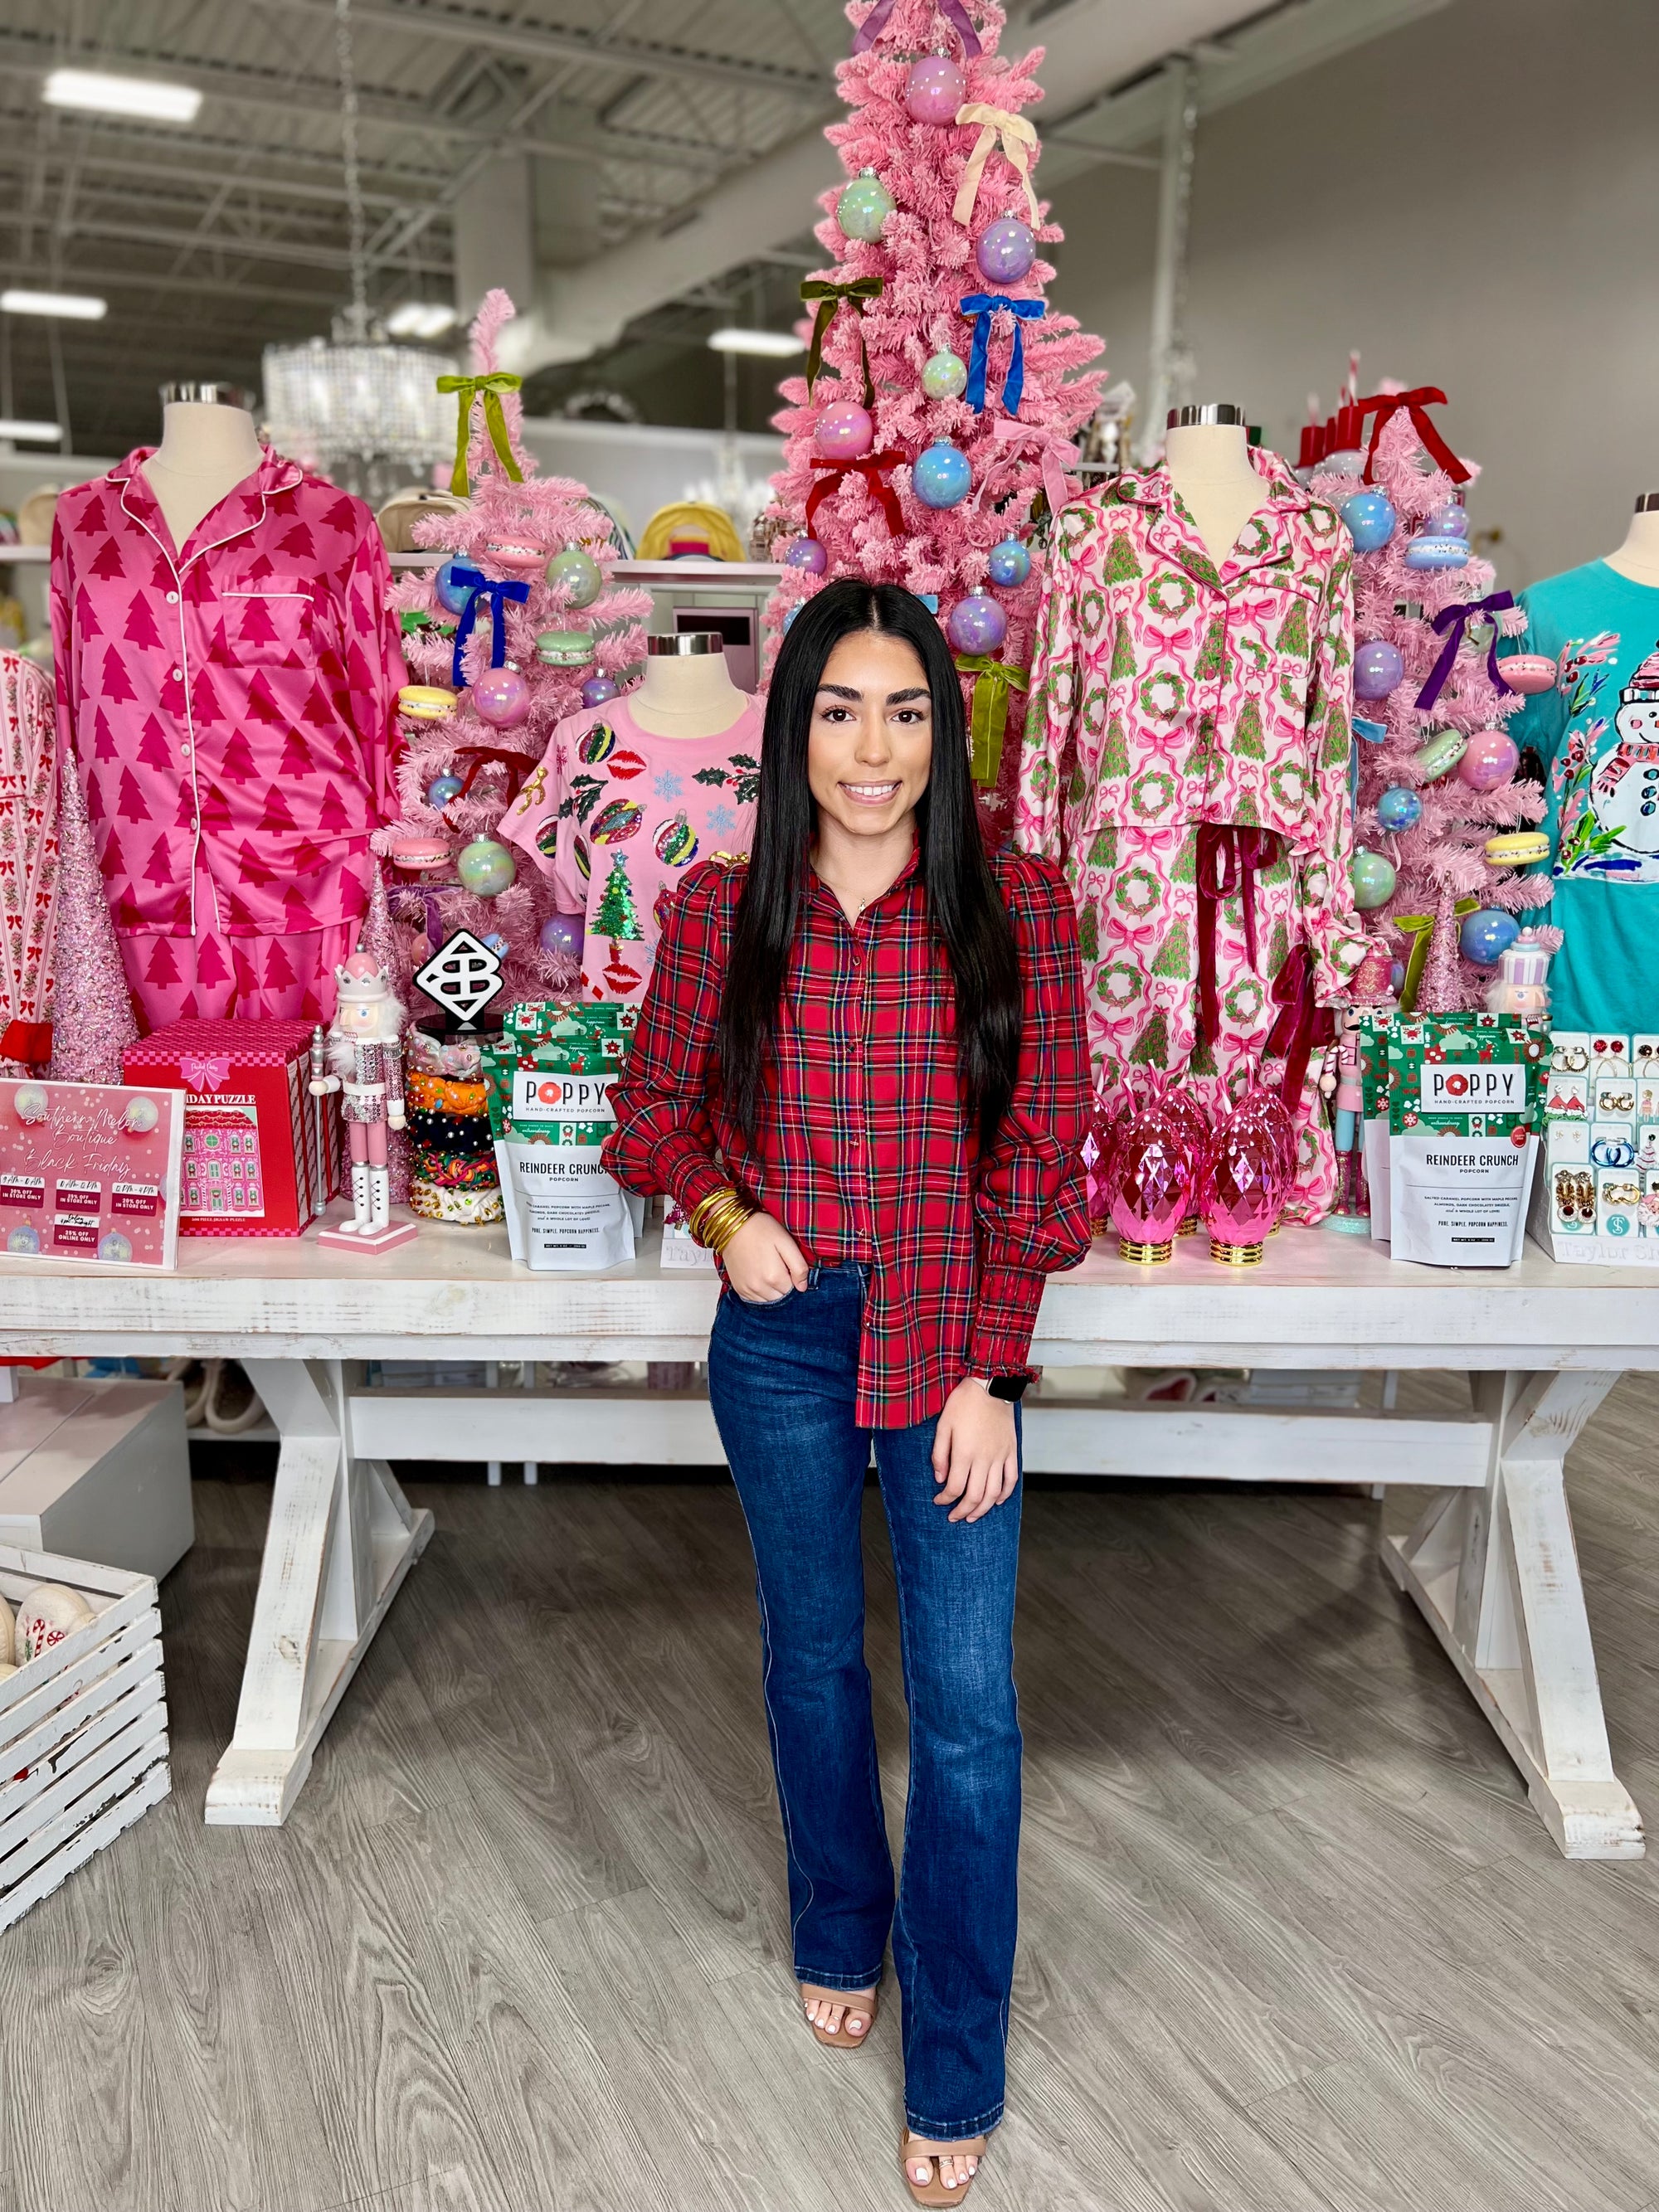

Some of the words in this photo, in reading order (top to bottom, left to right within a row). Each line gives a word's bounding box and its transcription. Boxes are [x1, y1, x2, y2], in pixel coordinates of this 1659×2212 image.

[526, 1081, 605, 1105] POPPY
[1433, 1073, 1513, 1096] POPPY
[214, 1094, 256, 1104] PUZZLE
[23, 1103, 92, 1129] Southern
[93, 1107, 142, 1130] Melon
[53, 1124, 118, 1151] Boutique
[24, 1149, 78, 1174] Black
[83, 1153, 131, 1181] Friday
[520, 1162, 565, 1174] REINDEER
[569, 1164, 607, 1174] CRUNC
[1426, 1155, 1476, 1166] REINDEER
[1479, 1155, 1519, 1166] CRUNCH
[1558, 1241, 1629, 1262] Taylor
